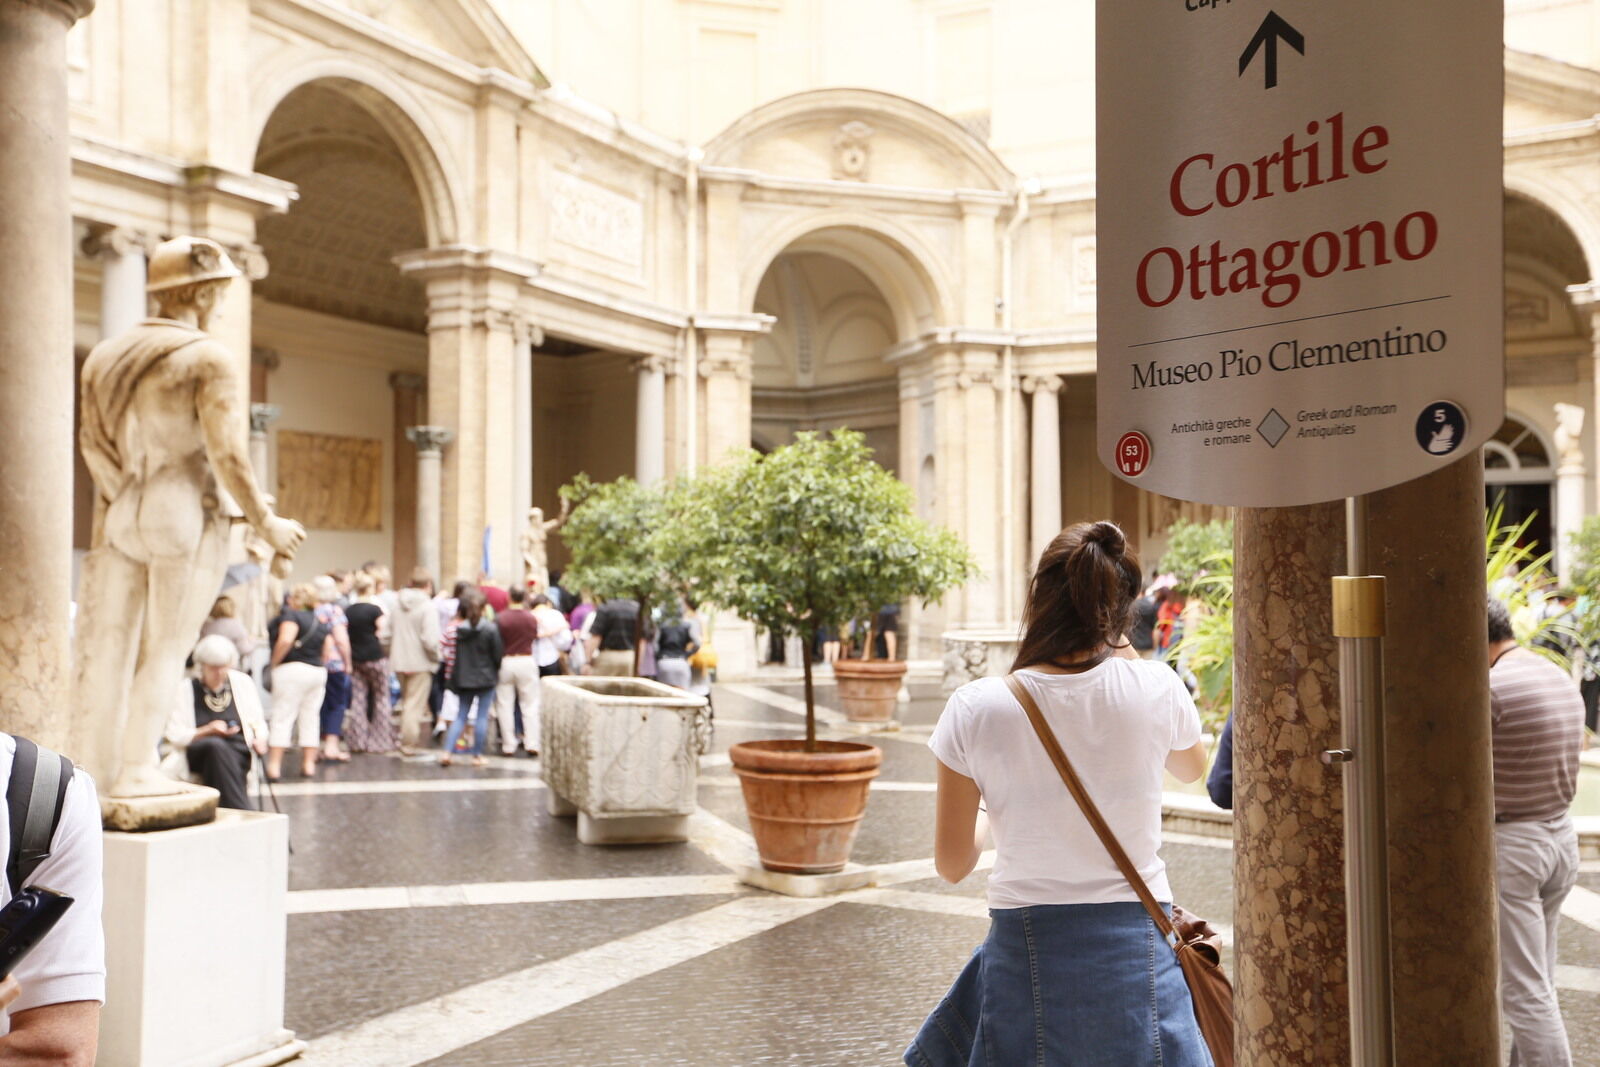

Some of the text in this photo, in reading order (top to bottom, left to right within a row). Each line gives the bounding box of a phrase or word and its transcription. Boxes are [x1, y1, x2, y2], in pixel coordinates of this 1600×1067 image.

[1169, 111, 1389, 217] Cortile
[1135, 210, 1439, 308] Ottagono
[1131, 326, 1447, 390] Museo Pio Clementino
[1297, 403, 1398, 422] Greek and Roman
[1434, 409, 1446, 423] 5
[1170, 416, 1252, 434] Antichità greche
[1296, 423, 1357, 439] Antiquities
[1203, 433, 1252, 447] e romane
[1125, 445, 1139, 456] 53
